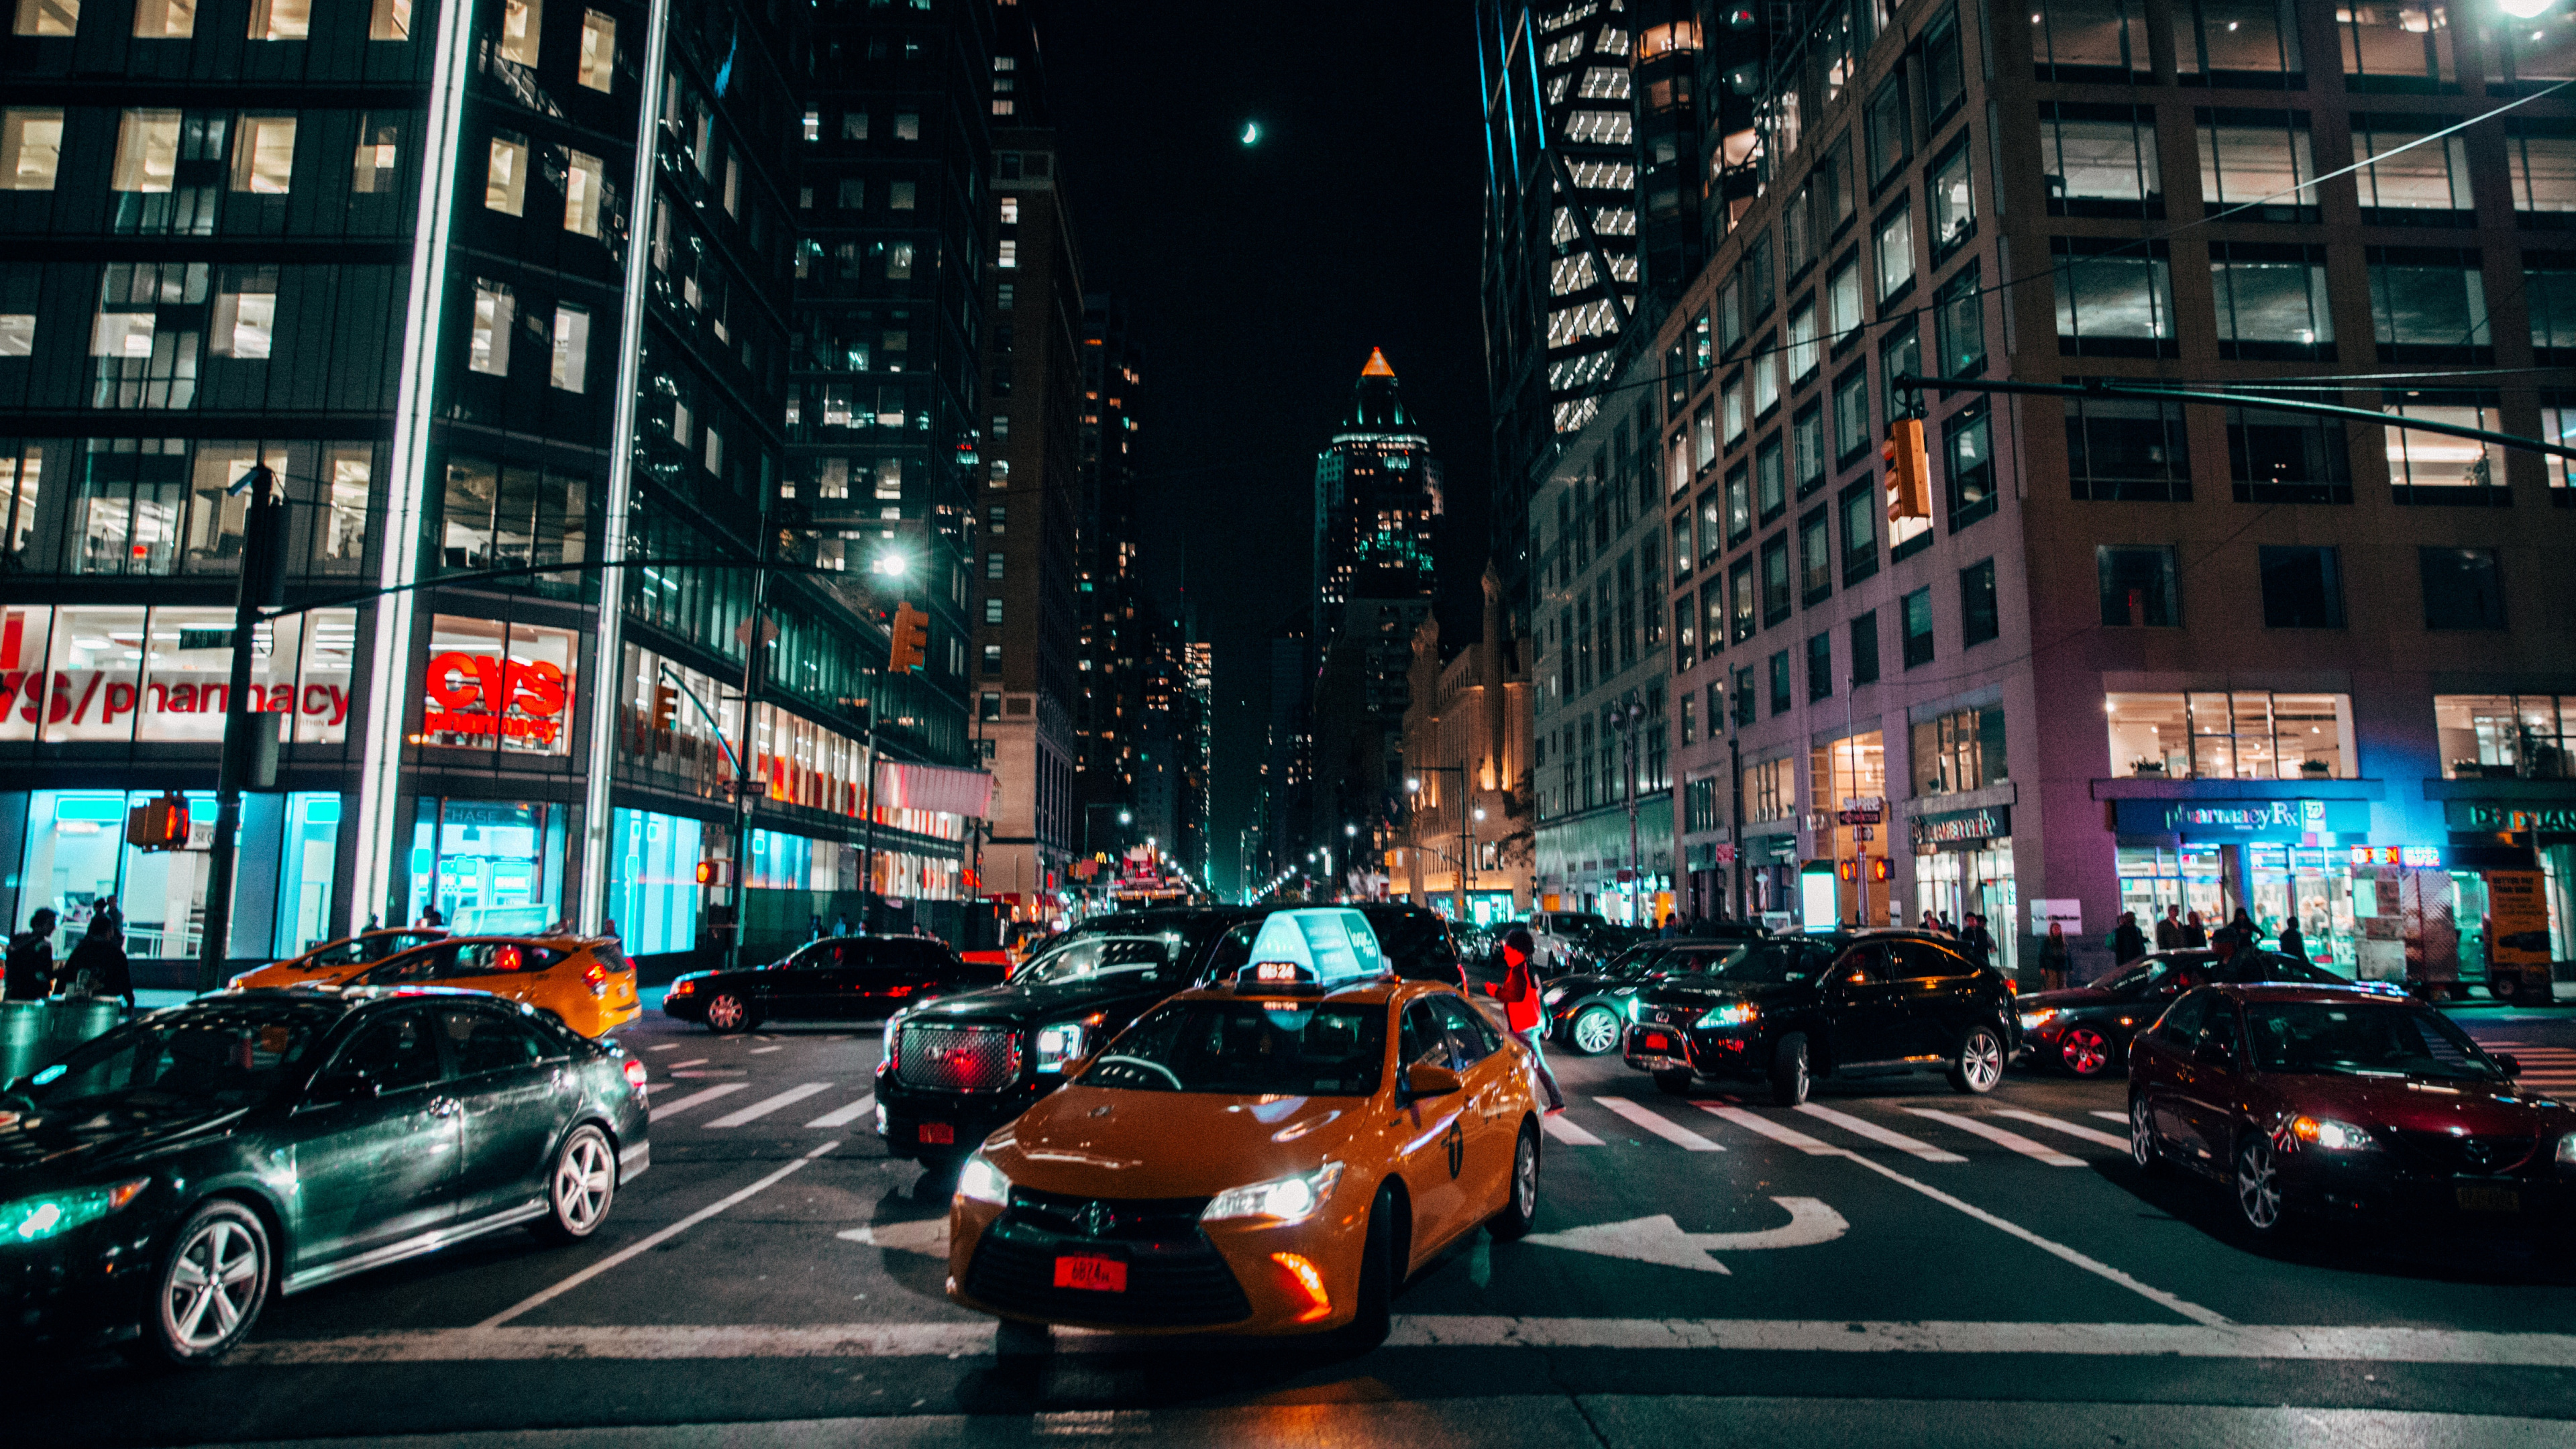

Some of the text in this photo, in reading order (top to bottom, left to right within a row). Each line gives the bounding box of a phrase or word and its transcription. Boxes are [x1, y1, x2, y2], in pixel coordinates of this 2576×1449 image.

[427, 651, 564, 716] CVS
[425, 711, 559, 745] pharmacy
[2351, 847, 2400, 865] OPEN
